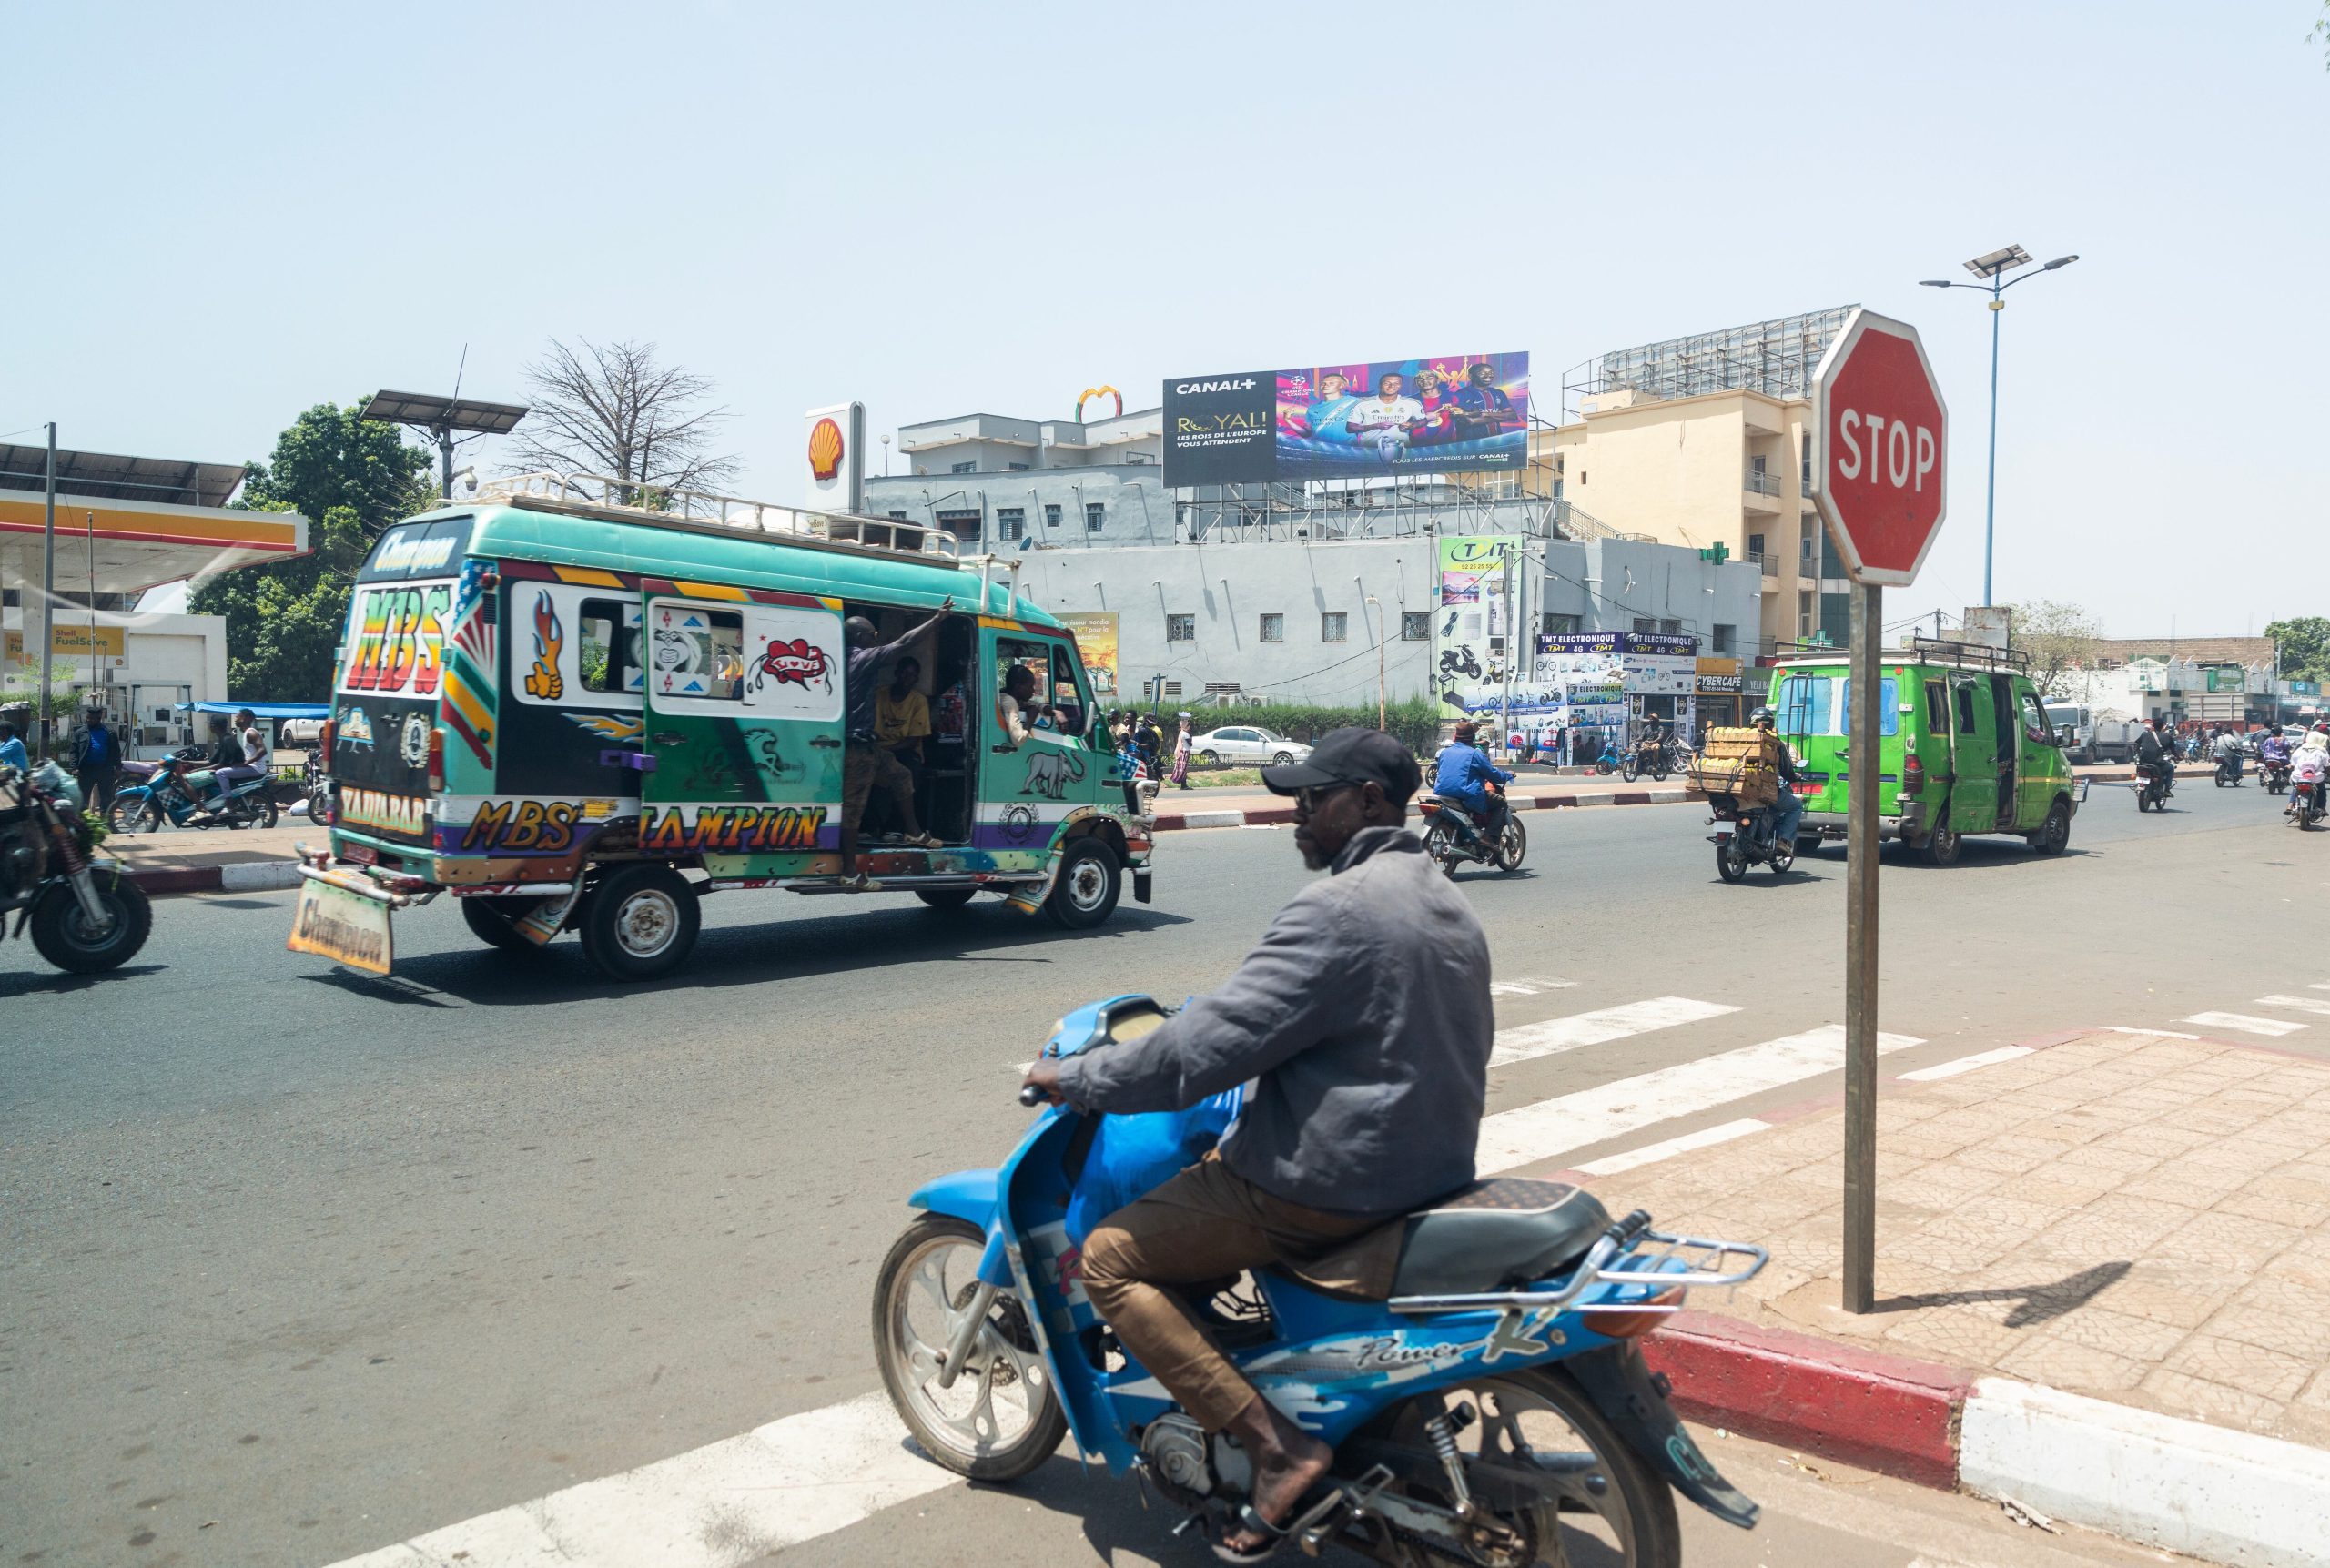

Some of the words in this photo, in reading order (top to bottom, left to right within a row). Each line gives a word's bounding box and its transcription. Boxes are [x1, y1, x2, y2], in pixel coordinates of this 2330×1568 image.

[1176, 379, 1256, 395] CANAL+
[1202, 437, 1251, 446] ATTENDENT
[1838, 408, 1935, 492] STOP
[374, 531, 458, 574] Champion
[56, 637, 108, 646] FuelSave
[347, 584, 452, 694] MBS
[1558, 634, 1615, 642] ELECTRONIQUE
[1644, 635, 1691, 645] ELECTRONIQUE
[462, 801, 580, 851] MBS
[1357, 1338, 1464, 1367] Power
